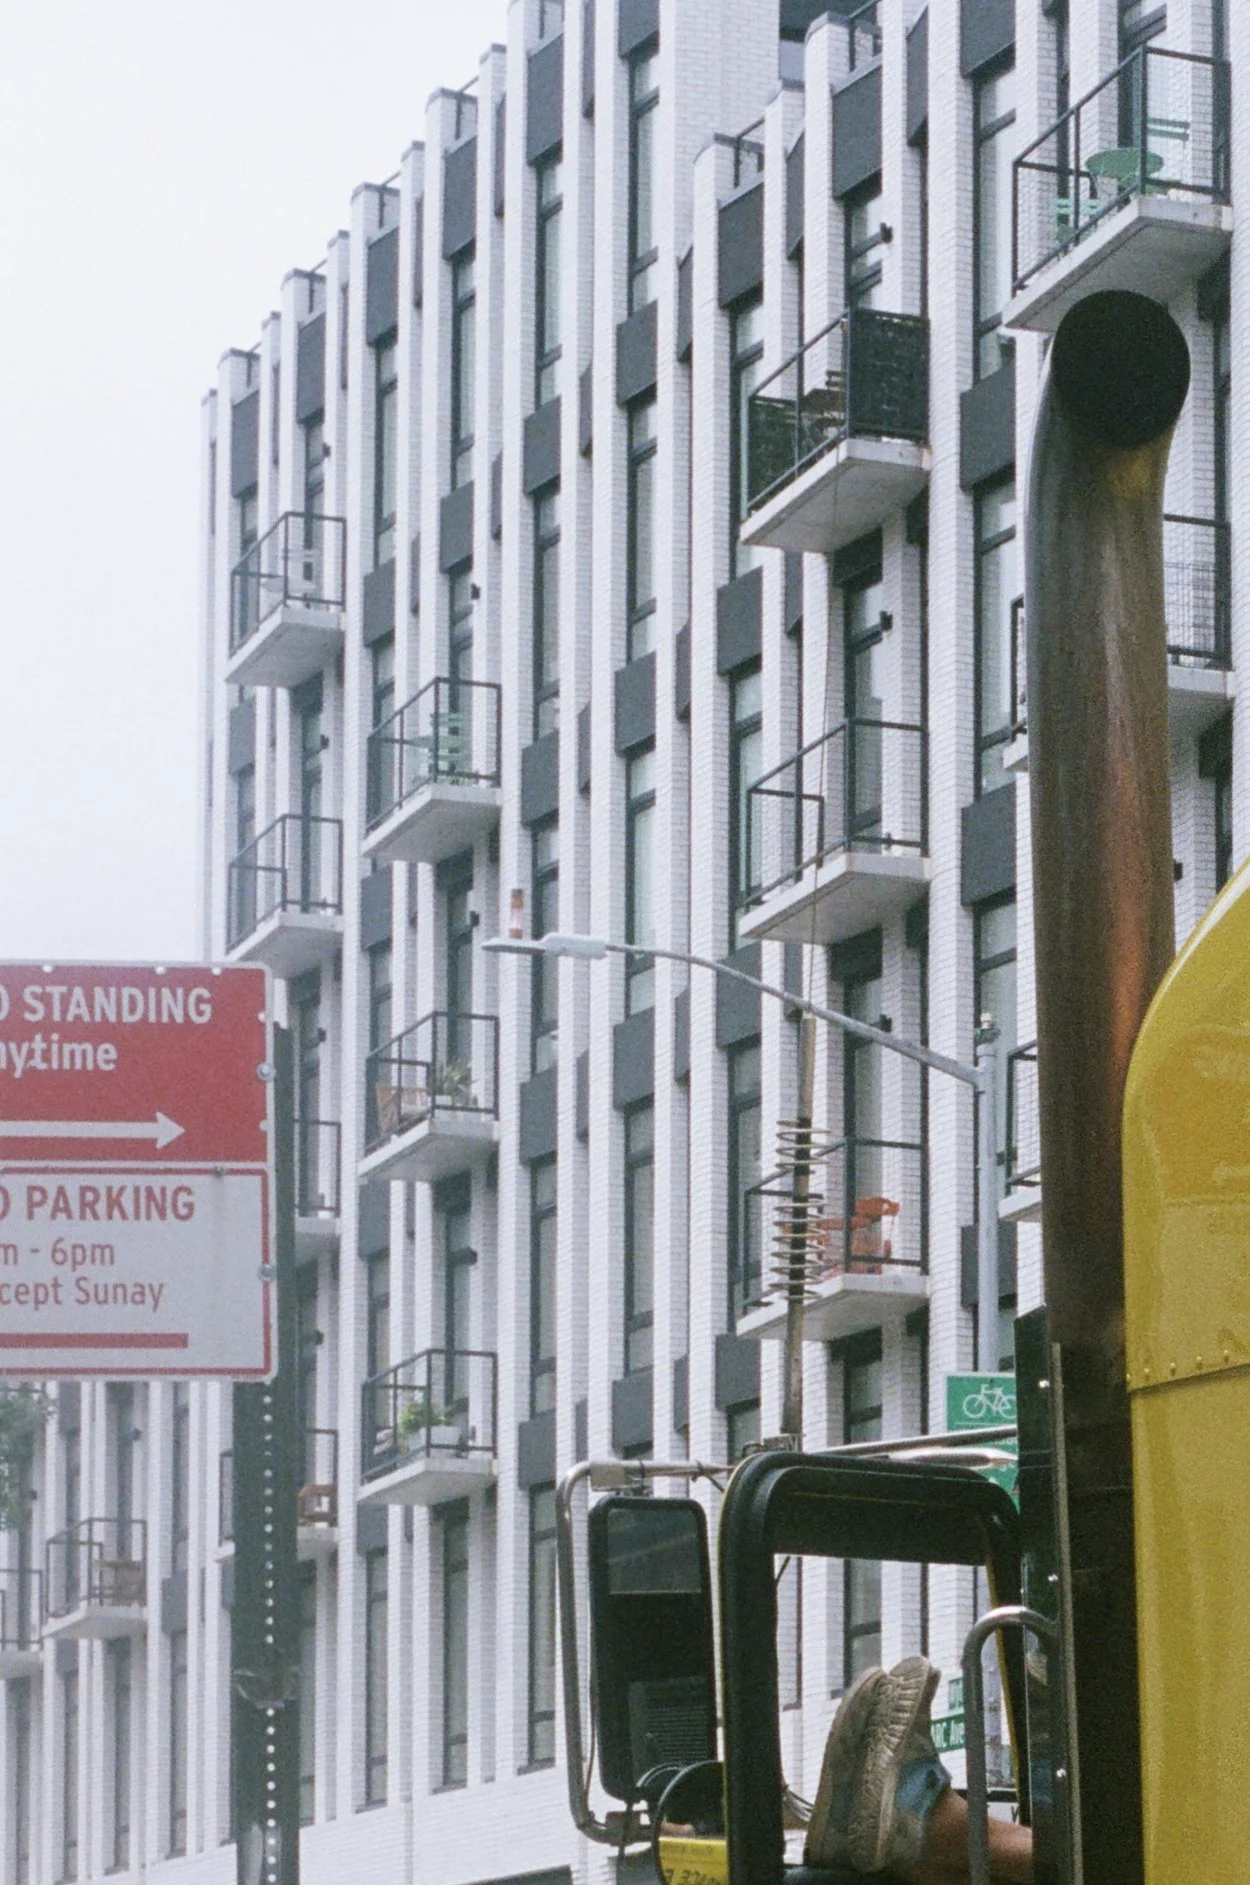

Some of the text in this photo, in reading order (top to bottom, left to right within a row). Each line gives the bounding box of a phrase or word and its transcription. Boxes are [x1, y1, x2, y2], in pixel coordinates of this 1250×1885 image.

[23, 985, 212, 1024] STANDING
[26, 1184, 196, 1222] PARKING
[51, 1237, 115, 1271] 6pm
[75, 1276, 164, 1312] Sunay
